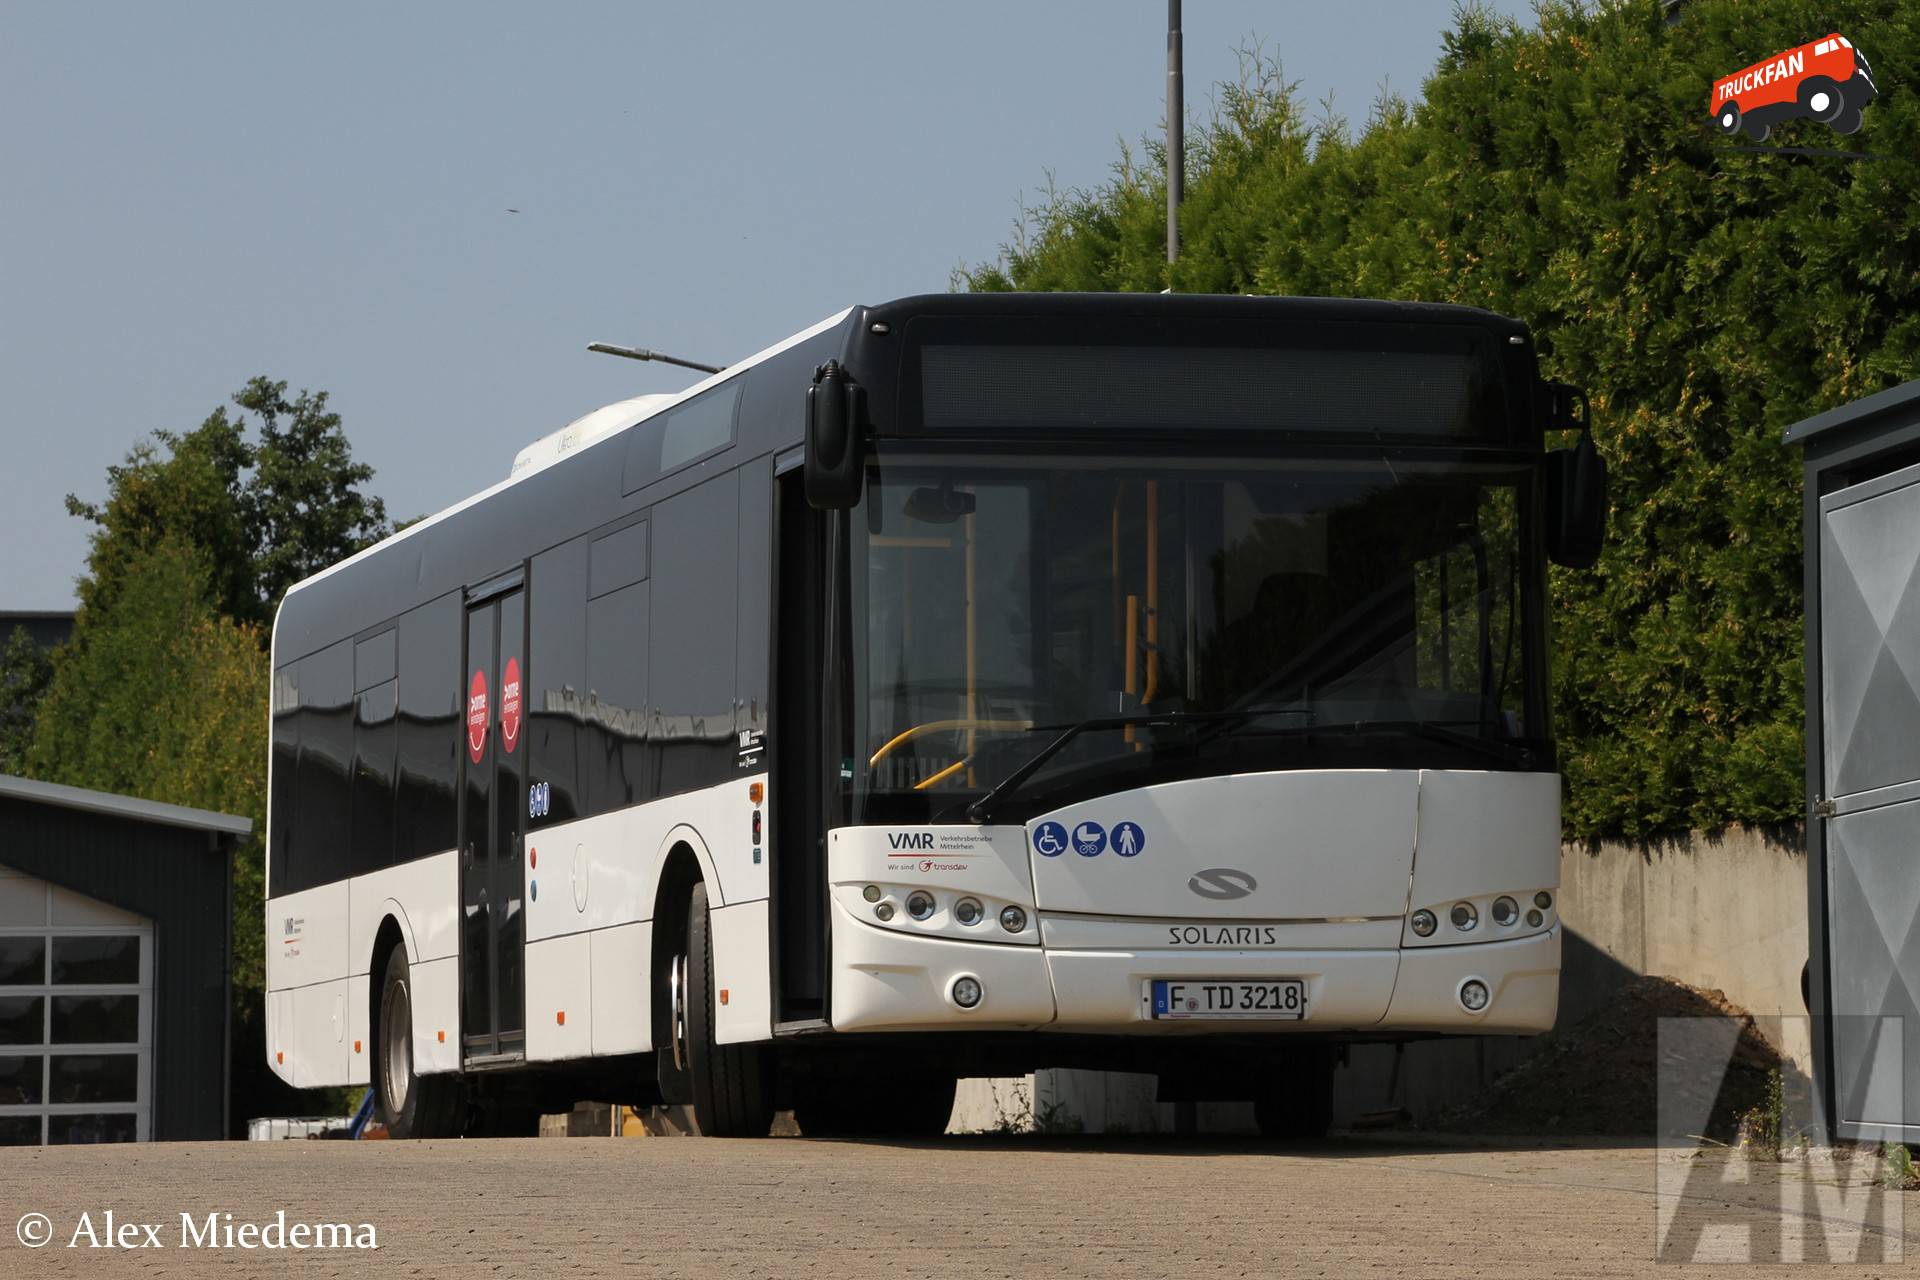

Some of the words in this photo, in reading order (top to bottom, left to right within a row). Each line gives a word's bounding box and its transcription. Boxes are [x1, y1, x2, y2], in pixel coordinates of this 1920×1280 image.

[887, 832, 935, 850] VMR
[940, 835, 993, 843] Verkehrsbetriebe
[933, 863, 968, 871] transdev
[1168, 926, 1277, 945] SOLARIS
[1170, 985, 1186, 1010] F
